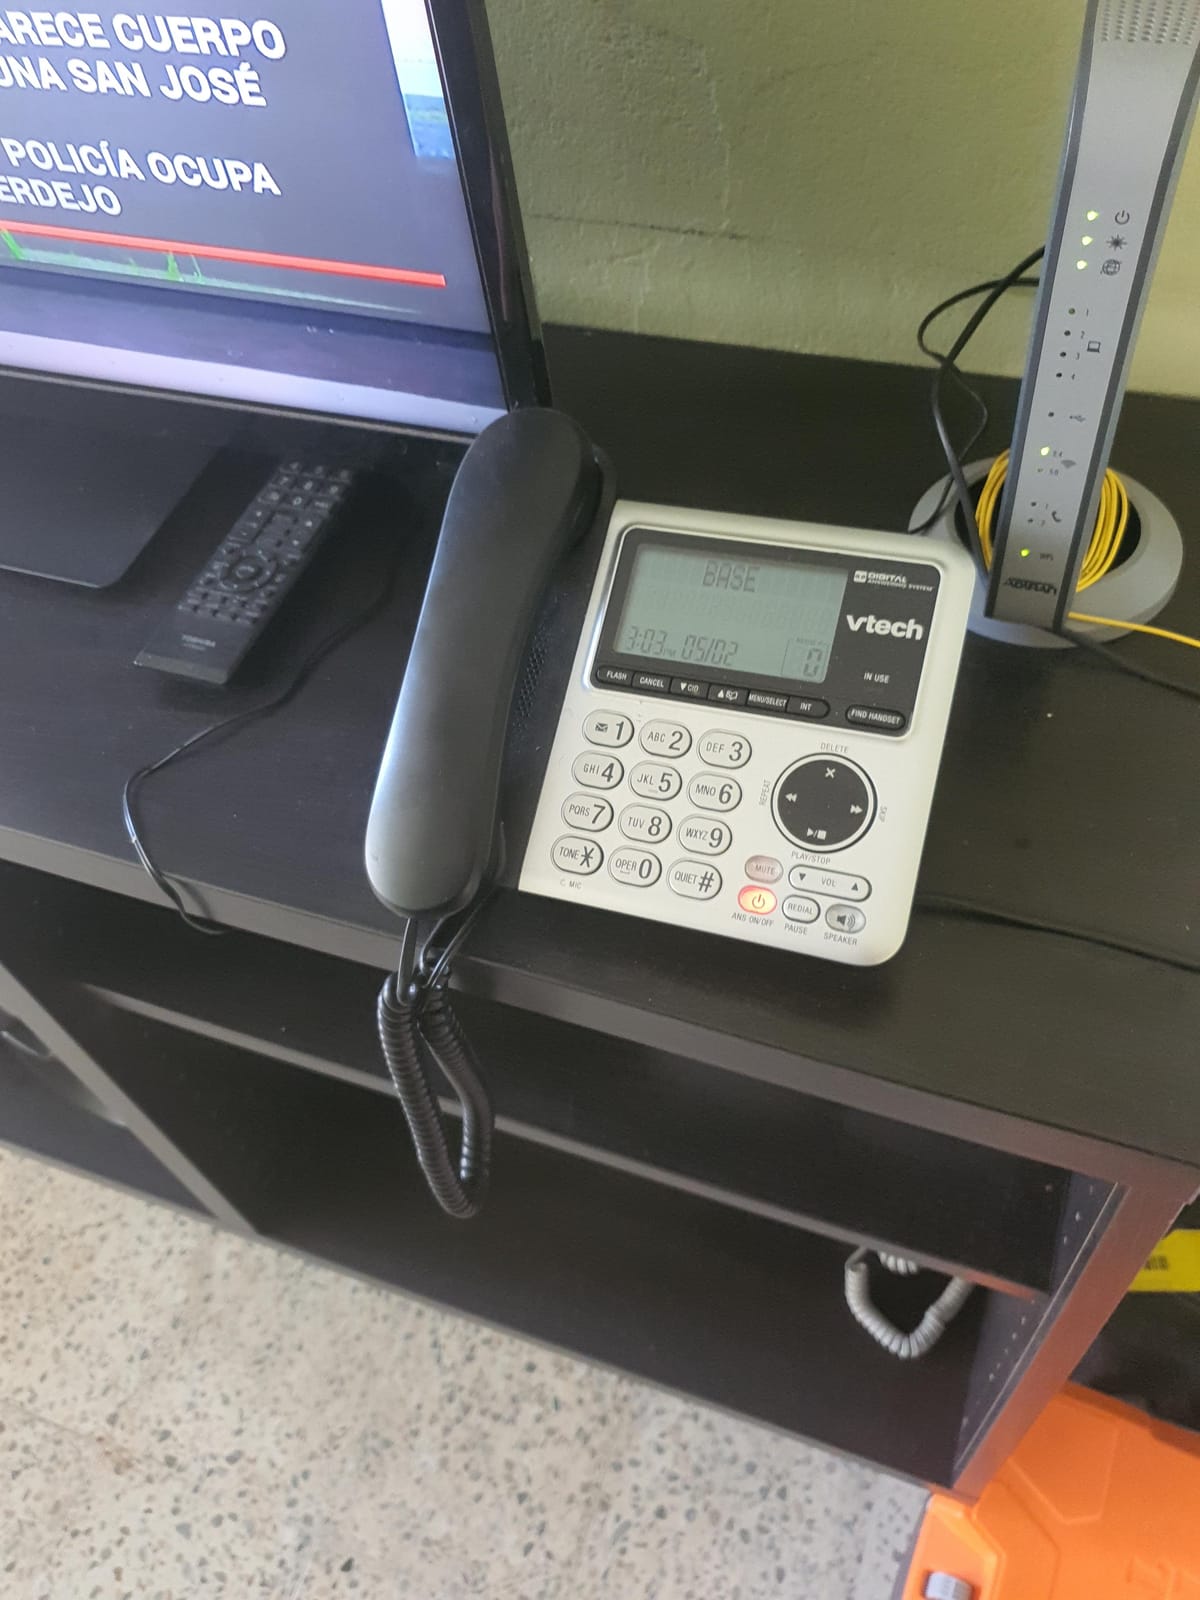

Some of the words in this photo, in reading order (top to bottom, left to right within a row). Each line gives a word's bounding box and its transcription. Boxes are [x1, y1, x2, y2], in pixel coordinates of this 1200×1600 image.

[0, 10, 111, 49] ARECE
[112, 13, 287, 60] CUERPO
[67, 58, 151, 97] SAN
[160, 62, 267, 107] JOSÉ
[0, 137, 146, 181] POLICÍA
[147, 151, 281, 196] OCUPA
[0, 175, 122, 216] ERDEJO
[702, 559, 760, 593] BASE
[867, 572, 907, 584] DIGITAL
[846, 614, 924, 641] vtech
[626, 626, 668, 656] 3:03
[681, 633, 739, 667] 05/02
[803, 647, 823, 677] 0
[606, 670, 628, 681] FLASH
[639, 677, 665, 688] CANCEL
[863, 672, 873, 681] IN
[874, 673, 890, 684] USE
[748, 693, 788, 707] MENU/SELECT
[800, 702, 813, 712] INT
[851, 708, 868, 719] FIND
[868, 711, 901, 725] HANDSET
[615, 721, 625, 741] 1
[647, 731, 666, 743] ABC
[669, 730, 684, 751] 2
[706, 741, 725, 753] DEF
[729, 741, 744, 762] 3
[820, 742, 849, 754] DELETE
[583, 763, 600, 776] GHI
[601, 762, 615, 783] 4
[637, 773, 654, 786] JKL
[658, 772, 673, 793] 5
[695, 784, 717, 797] MNO
[718, 783, 733, 805] 6
[758, 779, 772, 806] REPEAT
[569, 804, 591, 817] PQRS
[591, 804, 606, 824] 7
[627, 816, 645, 829] TUV
[647, 815, 662, 837] 8
[685, 827, 709, 841] WXYZ
[708, 827, 724, 848] 9
[558, 846, 580, 860] TONE
[791, 851, 831, 865] PLAY/STOP
[615, 859, 637, 873] OPER
[638, 858, 653, 879] 0
[755, 865, 776, 876] MUTE
[674, 870, 699, 885] QUIET
[698, 871, 715, 893] #
[821, 877, 837, 888] VOL
[787, 902, 814, 915] REDIAL
[731, 912, 747, 922] ANS
[748, 916, 775, 927] ON/OFF
[784, 923, 808, 936] PAUSE
[823, 932, 858, 946] SPEAKER
